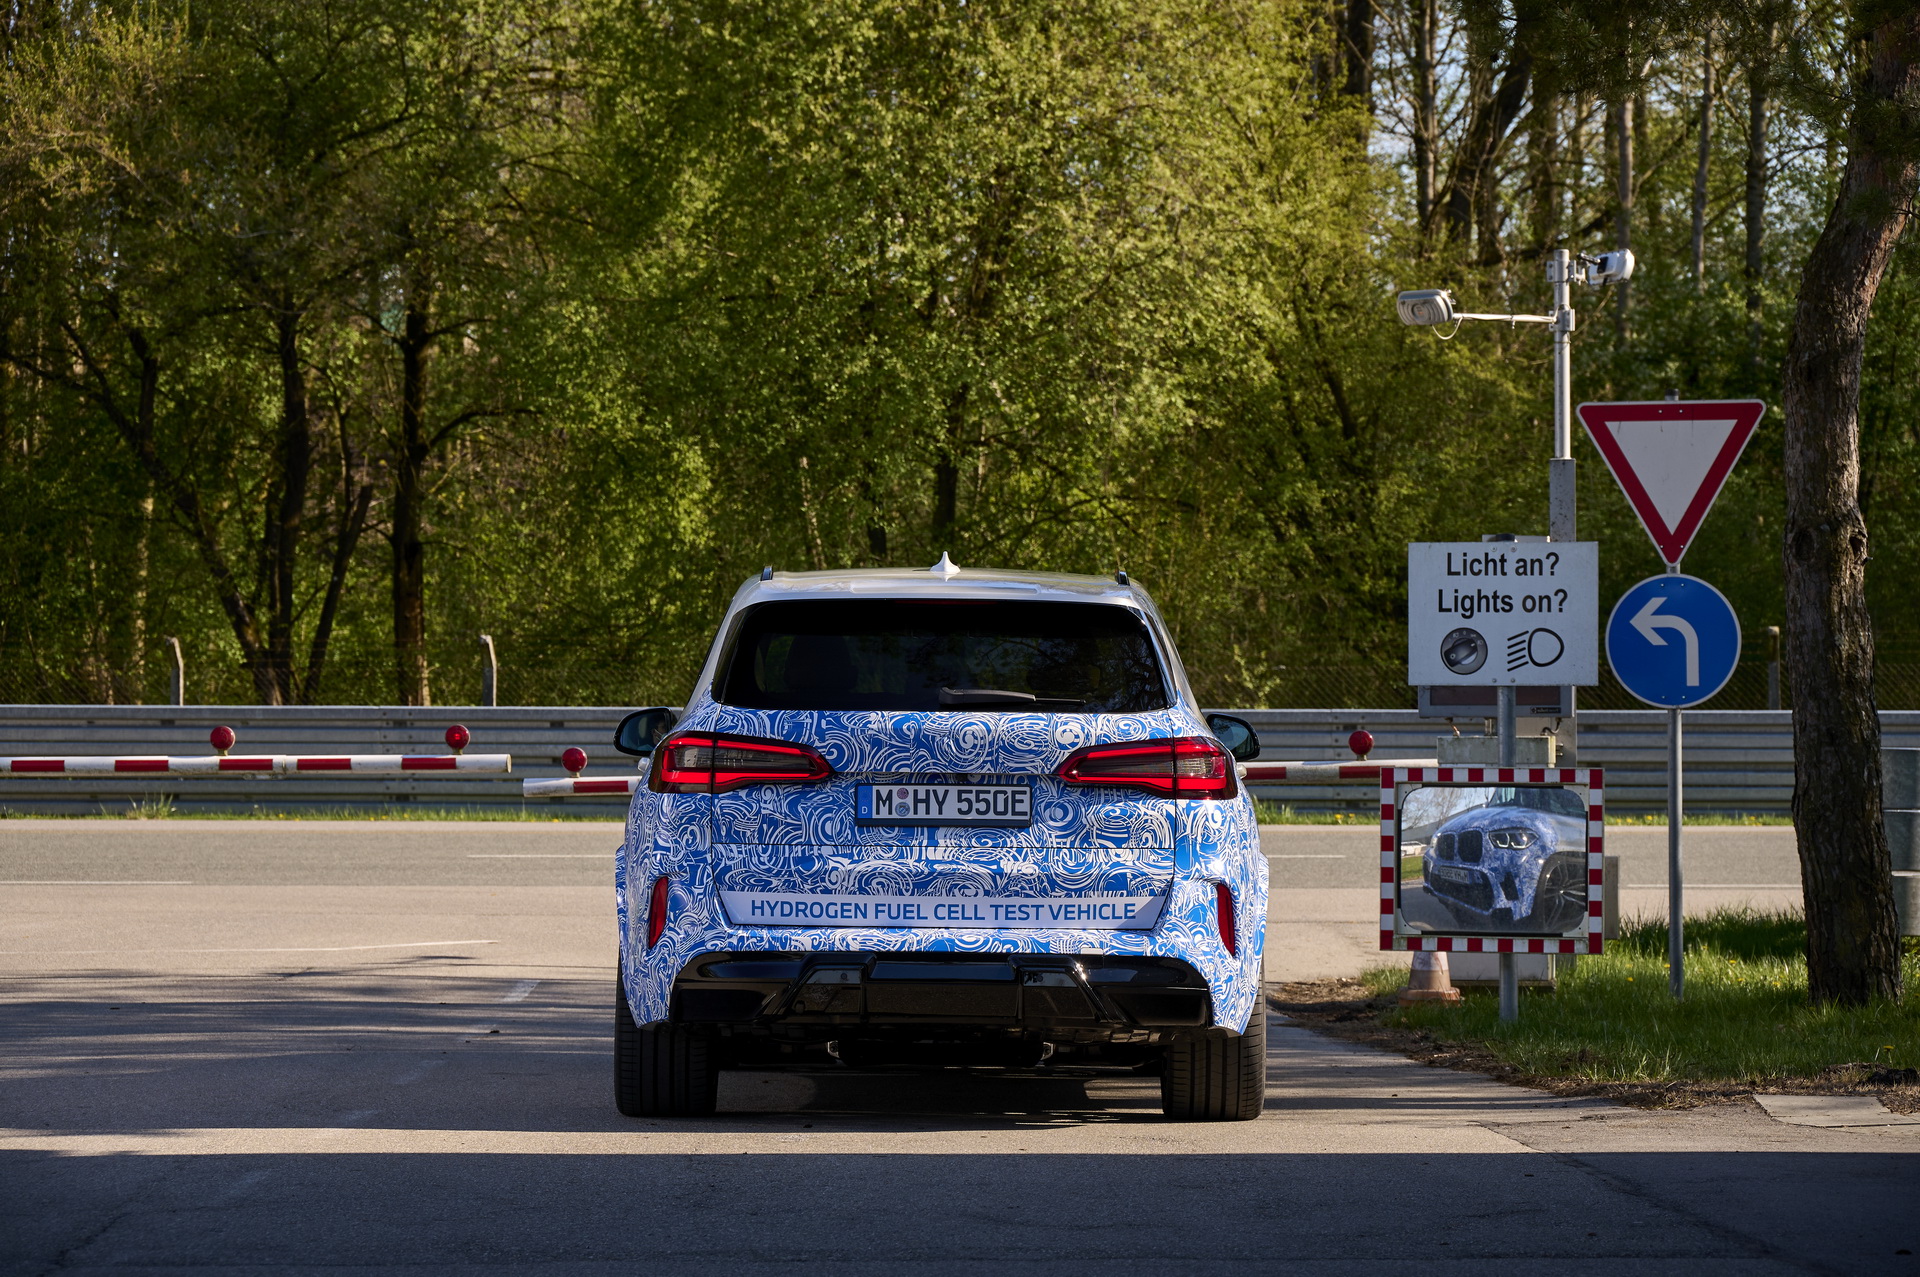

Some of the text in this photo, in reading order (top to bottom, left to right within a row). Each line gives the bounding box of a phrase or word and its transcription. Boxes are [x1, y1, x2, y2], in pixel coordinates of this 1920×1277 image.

[1447, 552, 1560, 576] Licht an?
[1438, 588, 1568, 619] Lights on?
[861, 806, 868, 814] D
[875, 789, 1028, 816] M HY 550E
[751, 900, 1136, 921] HYDROGEN FUEL CELL TEST VEHICLE
